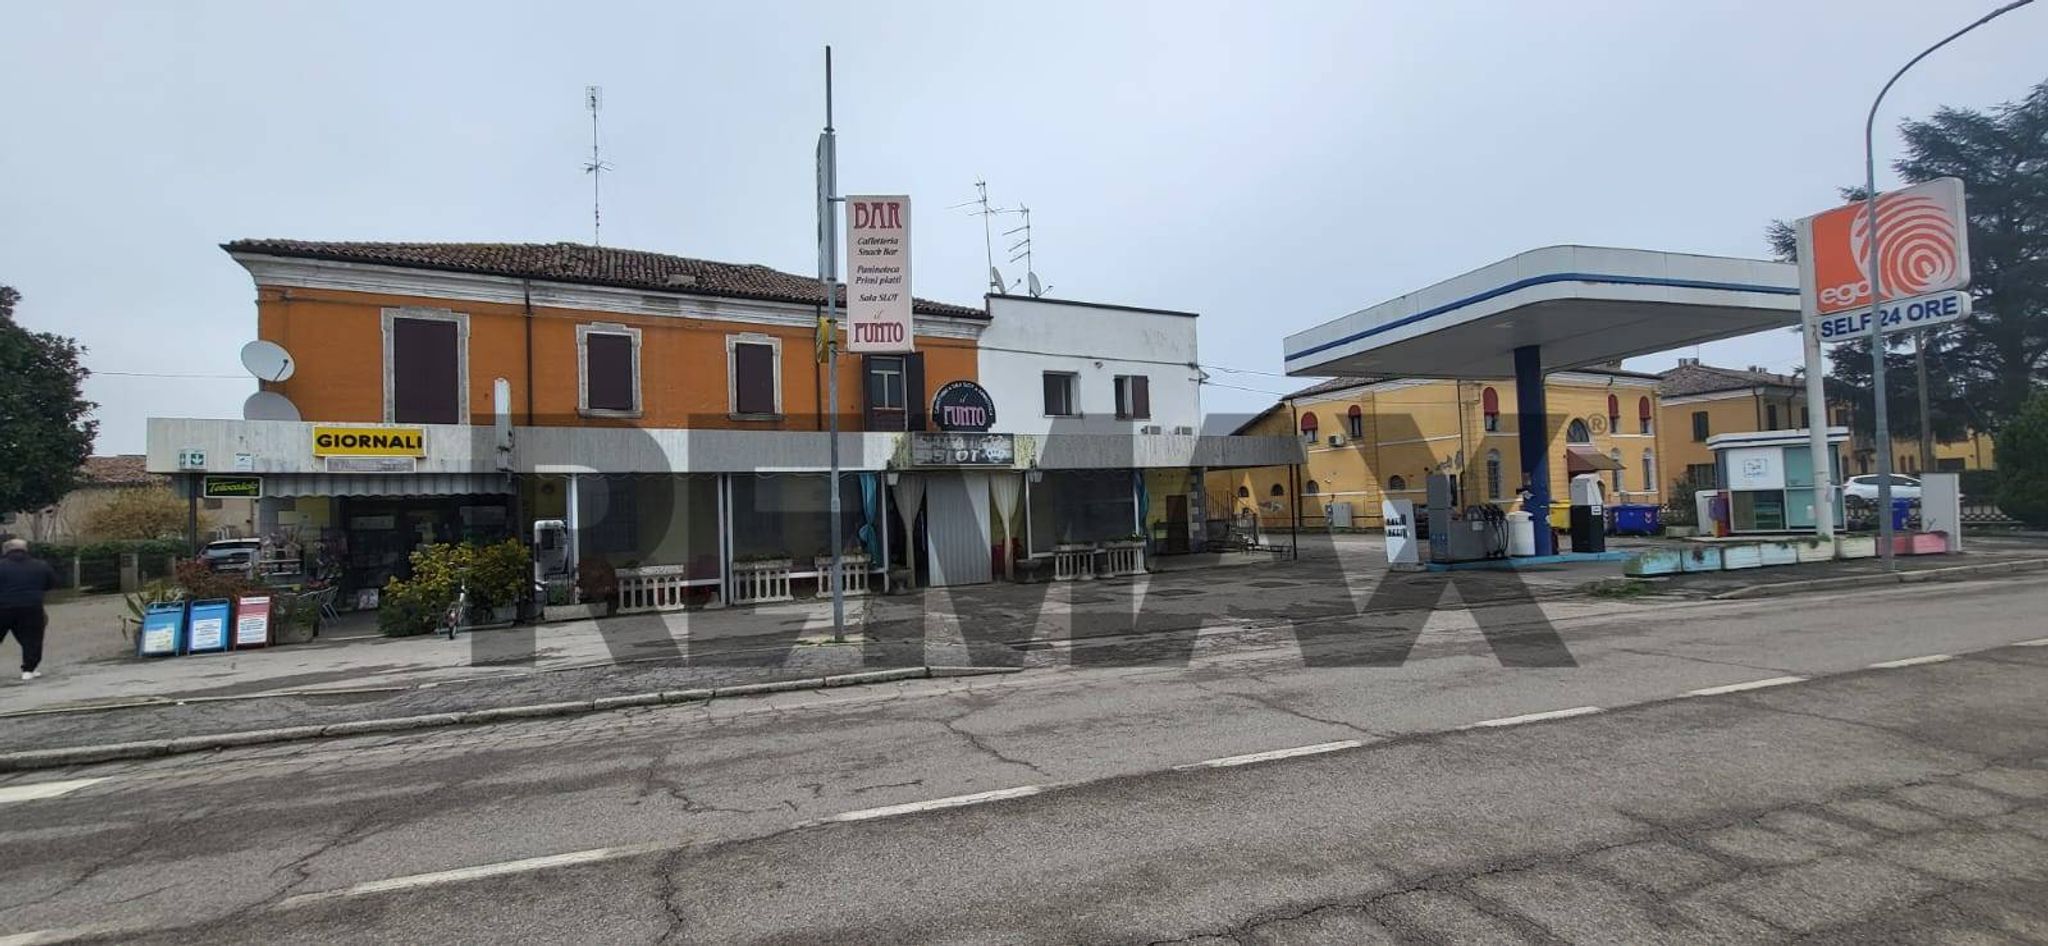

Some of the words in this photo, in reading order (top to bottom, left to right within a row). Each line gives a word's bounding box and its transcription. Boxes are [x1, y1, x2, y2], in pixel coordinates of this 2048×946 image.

[853, 202, 902, 229] BAR
[857, 236, 899, 245] Caffetteria
[857, 247, 882, 256] Snack
[883, 247, 899, 256] Bar
[857, 264, 900, 274] Paninoteca
[858, 292, 877, 302] Sala
[877, 292, 899, 302] SLOT
[1820, 312, 1872, 338] SELF
[1879, 307, 1902, 327] 24
[1906, 295, 1958, 322] ORE
[853, 321, 905, 343] PUNTO
[943, 405, 987, 426] PUNTO
[316, 433, 423, 449] GIORNALI
